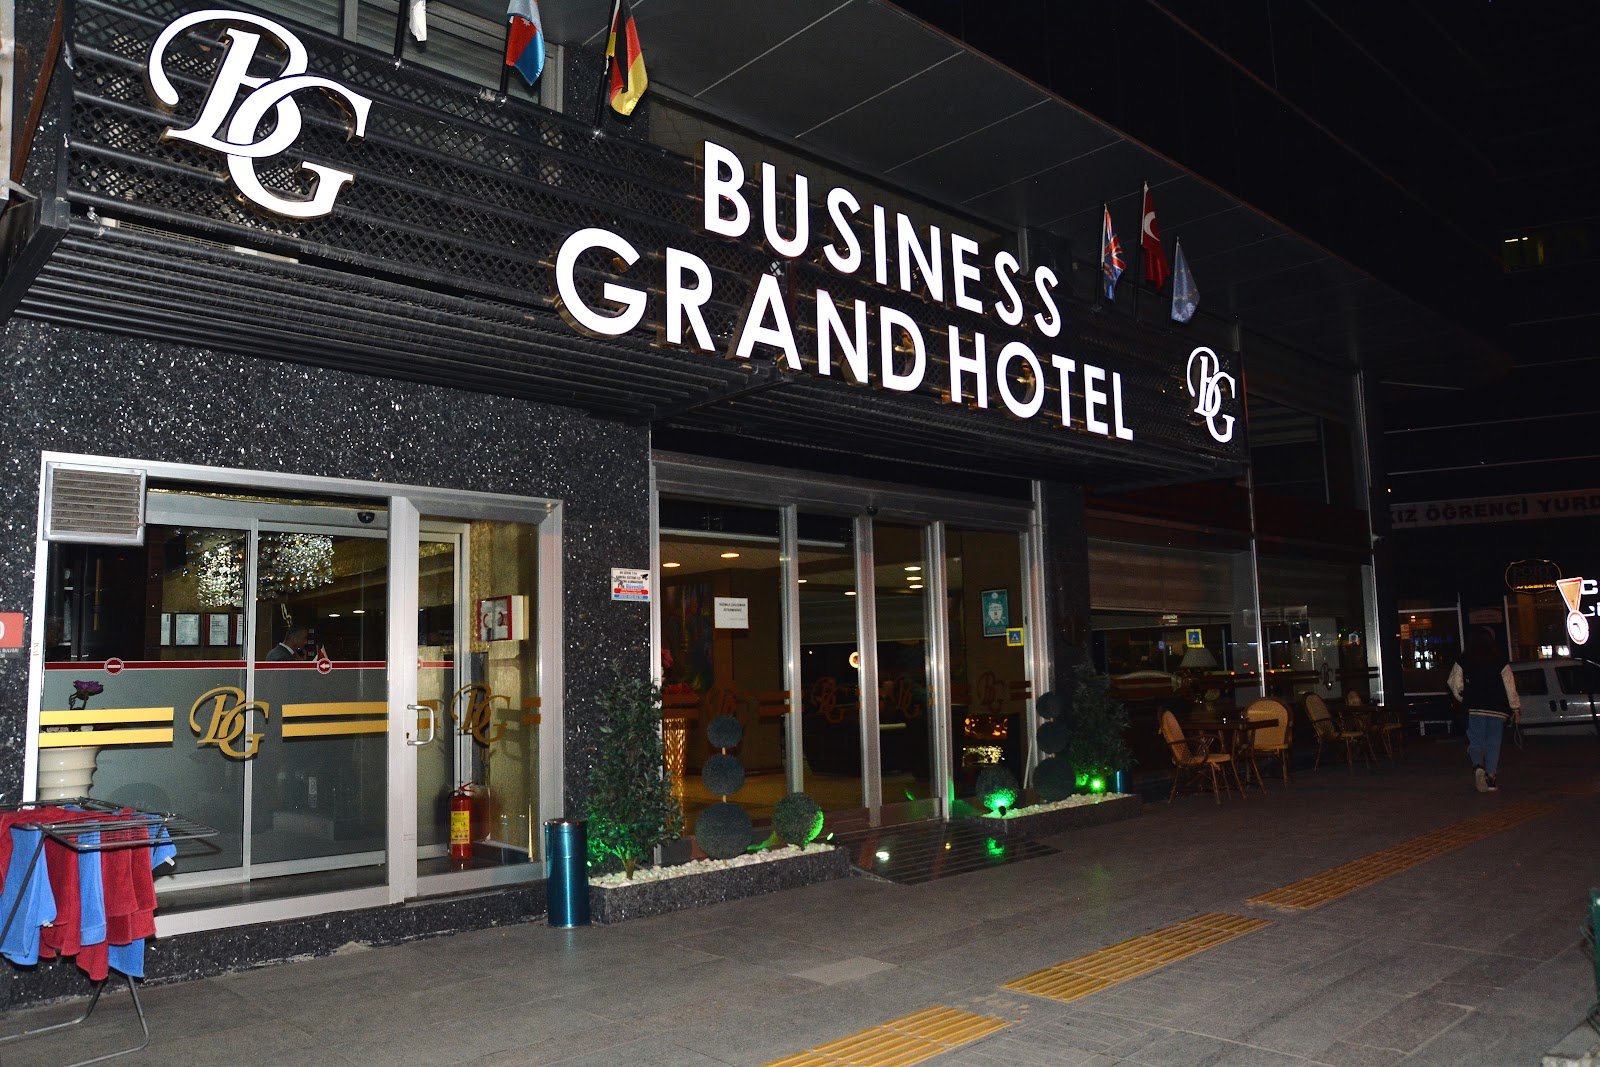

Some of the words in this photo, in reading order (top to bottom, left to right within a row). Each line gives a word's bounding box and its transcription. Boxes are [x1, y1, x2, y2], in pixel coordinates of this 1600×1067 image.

[556, 228, 927, 392] GRAND
[948, 325, 1133, 441] HOTEL
[704, 140, 1062, 338] BUSINESS
[1425, 497, 1529, 521] ÖĞRENCİ
